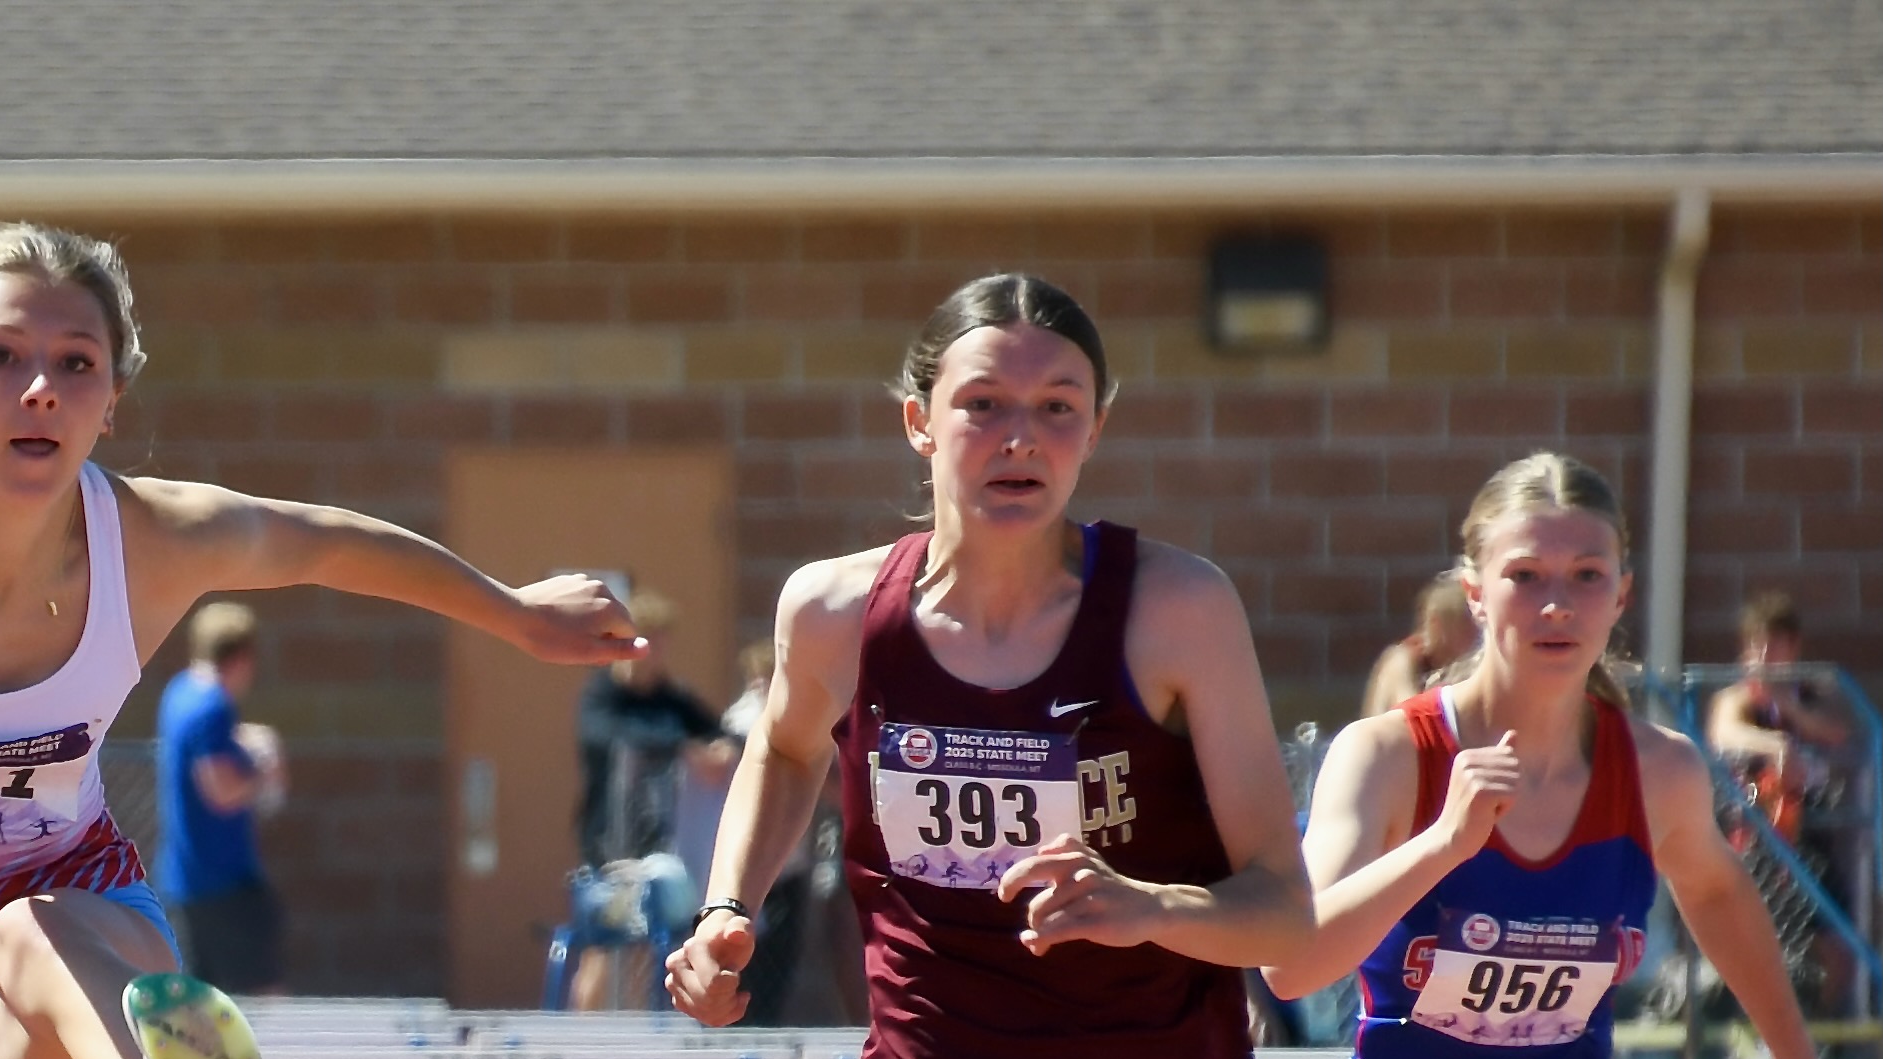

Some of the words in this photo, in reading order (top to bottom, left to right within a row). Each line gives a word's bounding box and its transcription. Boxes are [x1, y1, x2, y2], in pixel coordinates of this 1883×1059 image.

[944, 733, 985, 747] TRACK
[986, 736, 1014, 748] AND
[1016, 738, 1050, 750] FIELD
[944, 747, 975, 758] 2025
[976, 748, 1013, 761] STATE
[1016, 750, 1049, 762] MEET
[915, 779, 1042, 849] 393
[1461, 960, 1581, 1014] 956
